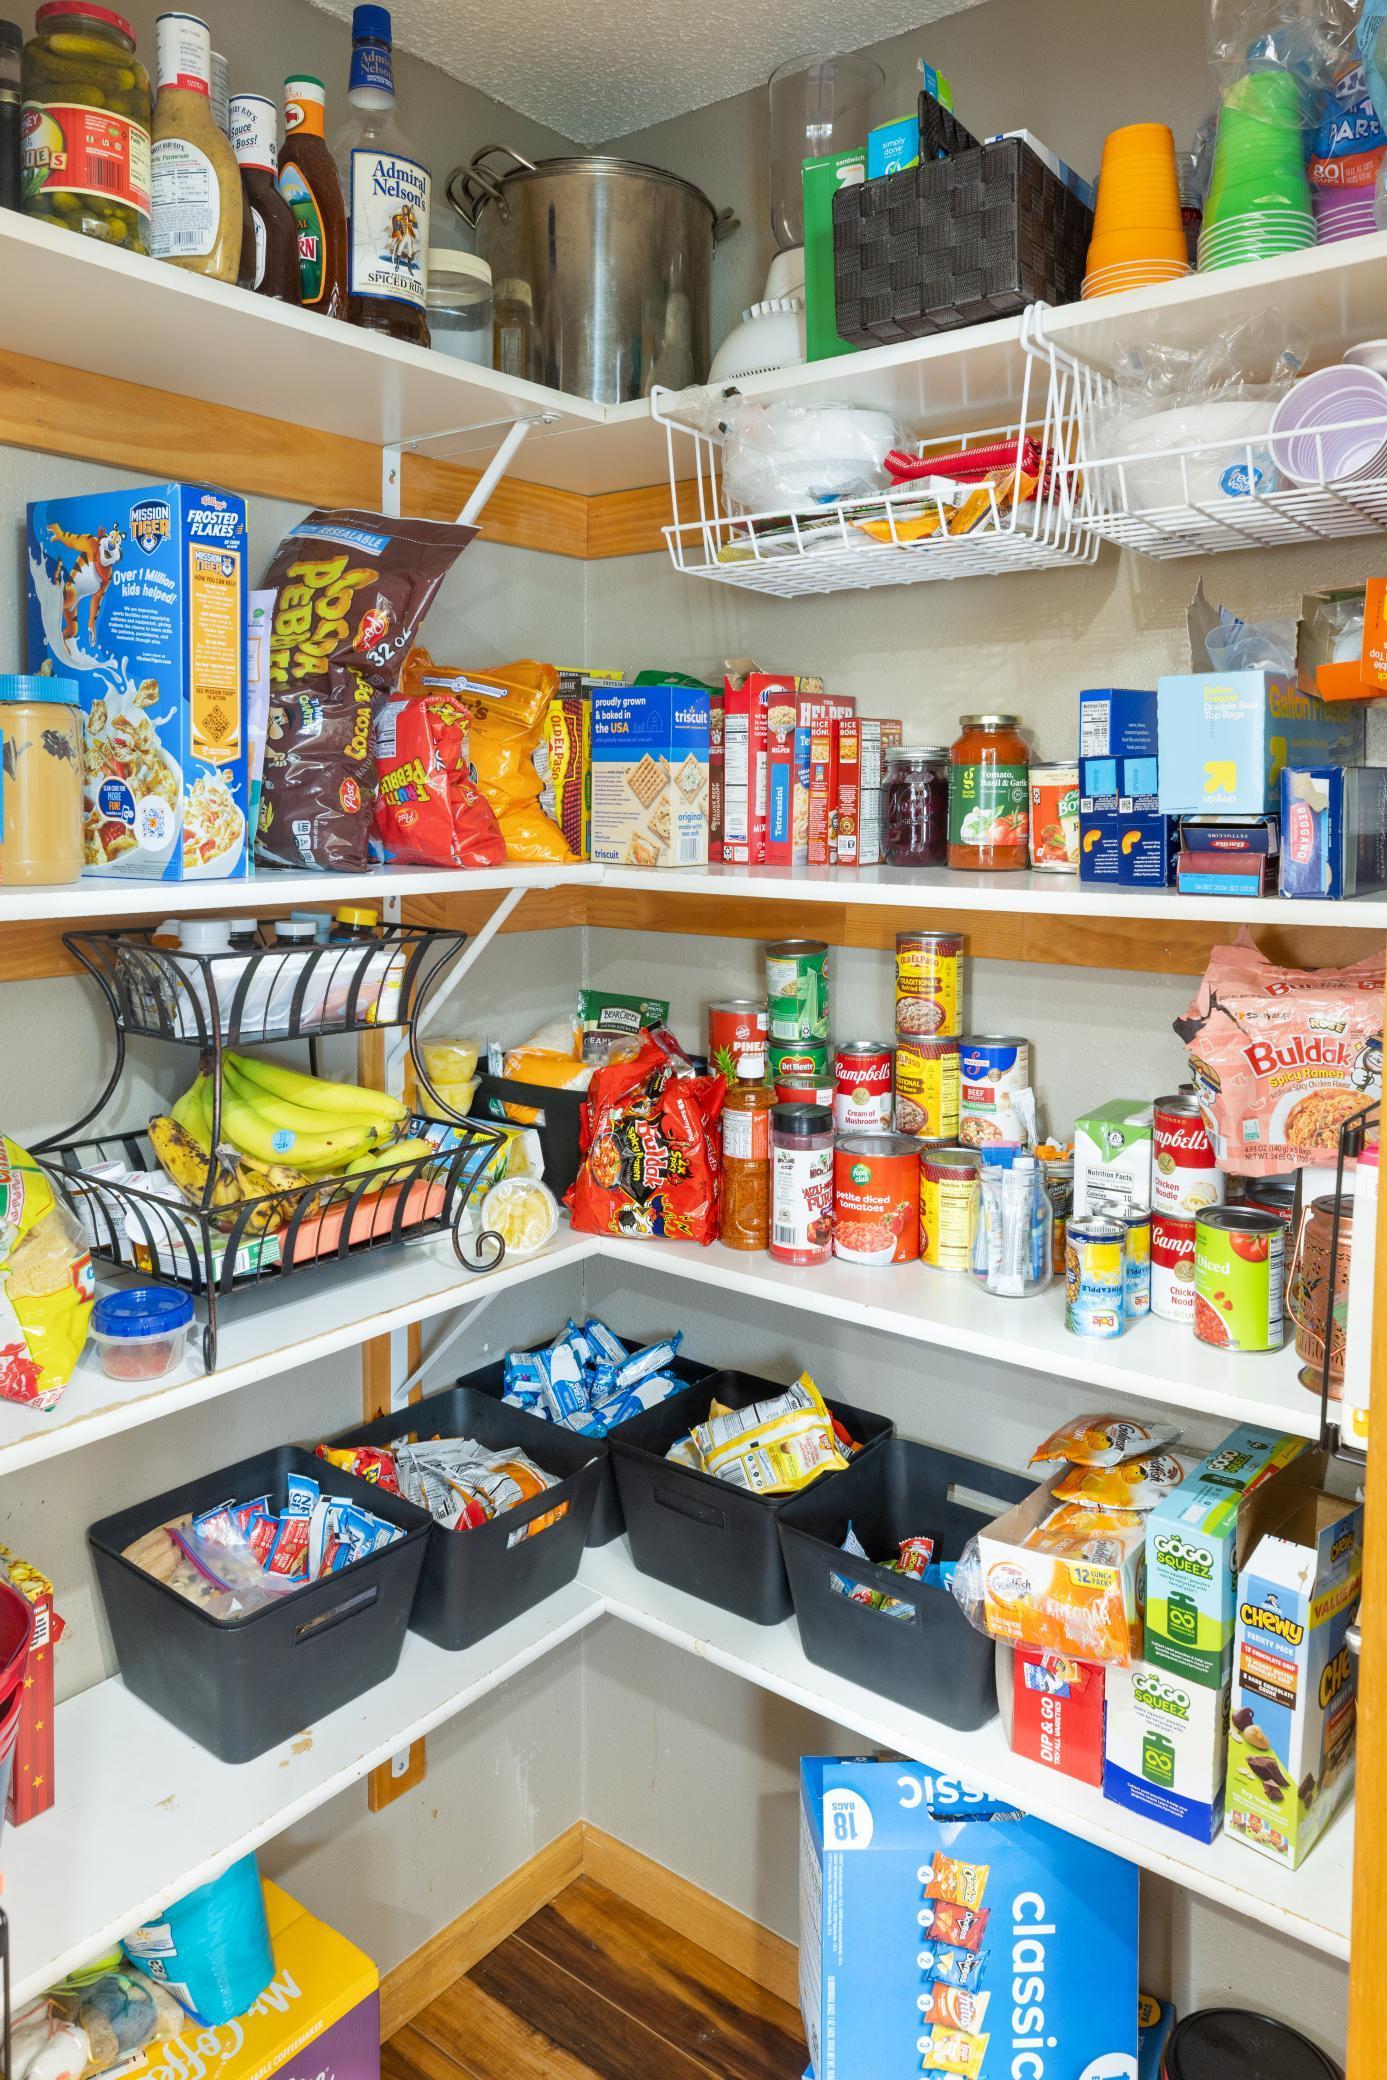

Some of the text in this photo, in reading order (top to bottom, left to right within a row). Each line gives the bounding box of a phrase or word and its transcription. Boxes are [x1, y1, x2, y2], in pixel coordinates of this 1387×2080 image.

[882, 137, 906, 149] simply
[836, 155, 865, 166] sandwich
[372, 159, 426, 196] Admiral
[373, 178, 427, 212] Nelson's
[368, 273, 425, 297] SPICED RUM
[131, 507, 169, 522] MISSION
[187, 509, 239, 525] FROSTED
[130, 519, 171, 539] TIGER
[190, 523, 235, 538] FLAKES
[318, 527, 385, 549] RESEALABLE
[195, 550, 222, 565] MISSION
[113, 568, 176, 591] Over 1 Million
[121, 584, 177, 606] kids helped!
[367, 643, 396, 667] 32
[595, 697, 646, 709] proudly grown
[1204, 701, 1260, 711] Double Seal
[1269, 684, 1311, 722] Gallon
[595, 710, 631, 720] & baked in
[674, 710, 708, 724] triscuit
[1204, 710, 1246, 721] Top Bags
[344, 706, 372, 761] COCOA
[595, 722, 629, 734] the USA
[981, 778, 1000, 786] Basil
[107, 792, 122, 801] MORE
[343, 782, 357, 810] Post
[1203, 793, 1238, 804] up&up
[109, 801, 121, 812] FUN!
[775, 786, 783, 836] Tetrazzini
[398, 811, 415, 825] Post
[678, 812, 703, 825] original
[1296, 807, 1310, 859] REGGANO
[595, 849, 619, 860] triscuit
[911, 954, 920, 963] EL
[900, 977, 940, 987] TRADITIONAL
[604, 1010, 640, 1022] BEAR CREEK
[1243, 1036, 1353, 1078] Buldak
[792, 1062, 813, 1070] Monte
[835, 1060, 891, 1086] Campbell's
[1269, 1067, 1345, 1087] Spicy Ramen
[968, 1089, 985, 1097] BEEF
[1270, 1079, 1352, 1099] Artificial Spicy Chicken Flavor
[845, 1116, 879, 1126] Mushroom
[847, 1109, 876, 1119] Cream of
[411, 1121, 418, 1130] 4
[628, 1126, 644, 1181] Spicy Ramen
[635, 1119, 669, 1189] Buldak
[1245, 1152, 1286, 1162] NET WT. 24.65
[1258, 1145, 1267, 1153] OZ
[1268, 1145, 1279, 1154] (140
[1280, 1146, 1289, 1156] g)
[1299, 1146, 1312, 1156] Bags
[852, 1168, 869, 1178] food
[855, 1174, 870, 1183] club
[1087, 1168, 1133, 1182] Nutrition Facts
[1155, 1178, 1180, 1191] Chicken
[836, 1191, 890, 1204] petite diced
[1087, 1190, 1132, 1203] Calories 10
[1155, 1187, 1178, 1201] Noodle
[840, 1200, 884, 1212] tomatoes
[1082, 1284, 1123, 1294] PINEAPPLE
[1092, 1314, 1115, 1327] Dole
[1074, 1567, 1091, 1584] 12
[1091, 1569, 1112, 1580] LUNCH
[991, 1575, 1032, 1591] Goldfish
[1314, 1591, 1344, 1620] VALUE
[1247, 1630, 1294, 1656] VARIETY PACK
[1244, 1645, 1296, 1671] 12 CHOCOLATE CHIP
[1263, 1680, 1294, 1699] CHOCOLATE
[1040, 1696, 1055, 1762] DIP & GO
[831, 1802, 856, 1811] BAGS
[832, 1811, 859, 1841] 18
[961, 1866, 978, 1906] Cheetos
[959, 1911, 973, 1942] Doritos
[960, 1953, 975, 1985] Doritos
[1011, 1892, 1058, 2080] classic
[272, 2019, 325, 2067] COFFEEMAKER
